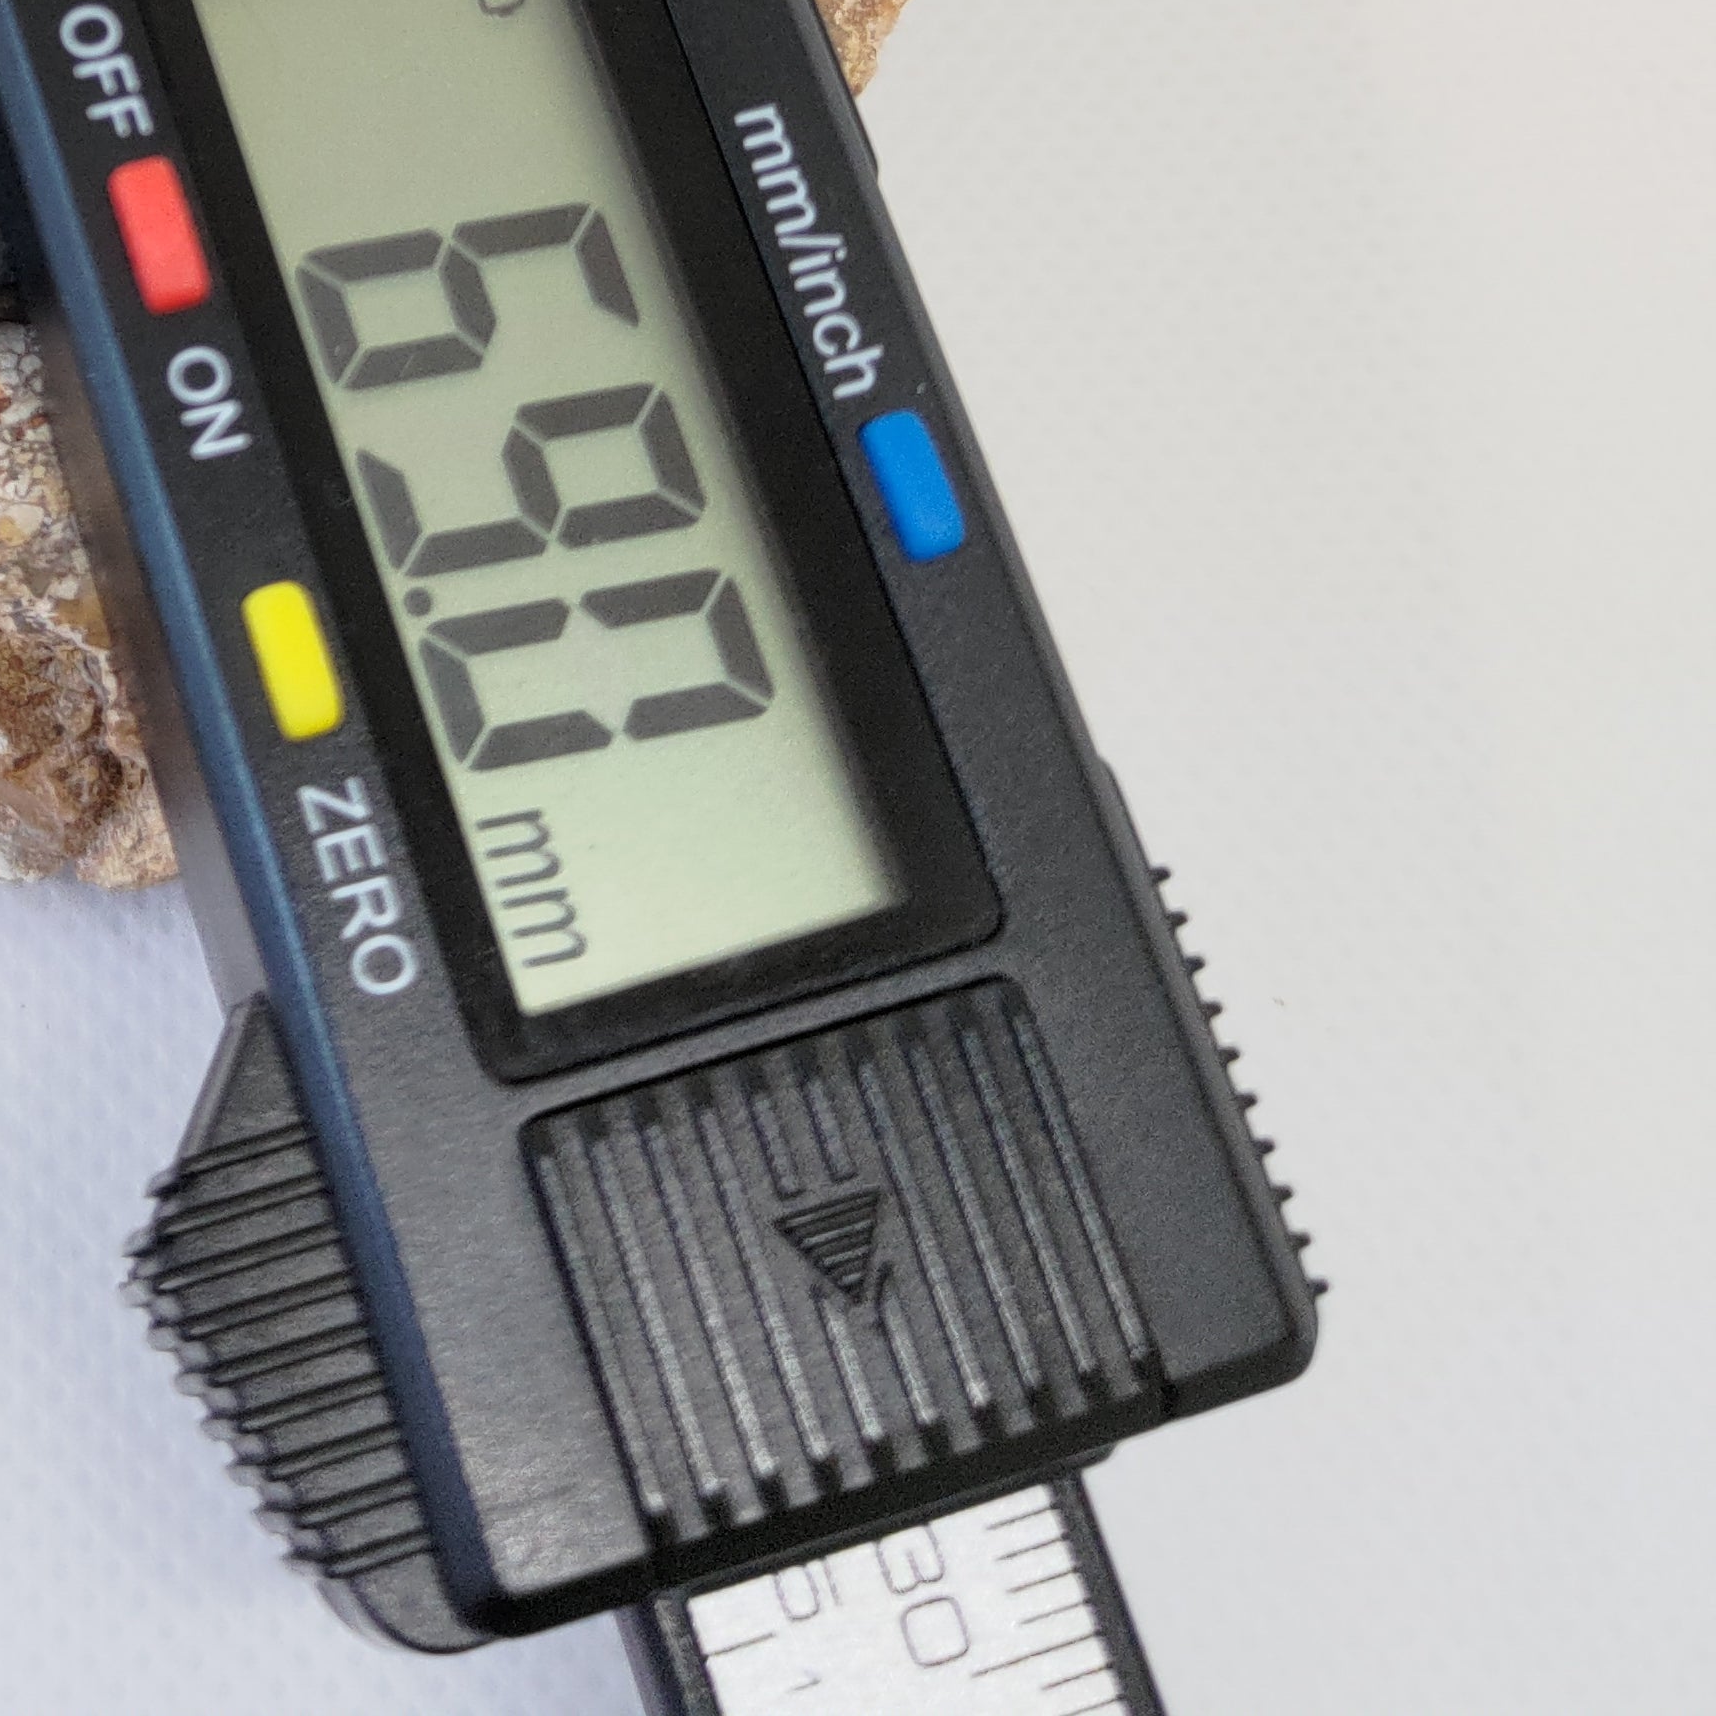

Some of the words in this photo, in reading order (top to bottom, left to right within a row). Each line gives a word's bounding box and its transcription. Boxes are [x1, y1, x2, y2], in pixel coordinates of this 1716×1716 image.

[59, 4, 153, 138] OFF
[735, 105, 881, 400] mm/inch
[167, 347, 252, 459] ON
[294, 201, 774, 771] 69.0
[297, 777, 416, 996] ZERO
[473, 809, 586, 969] mm
